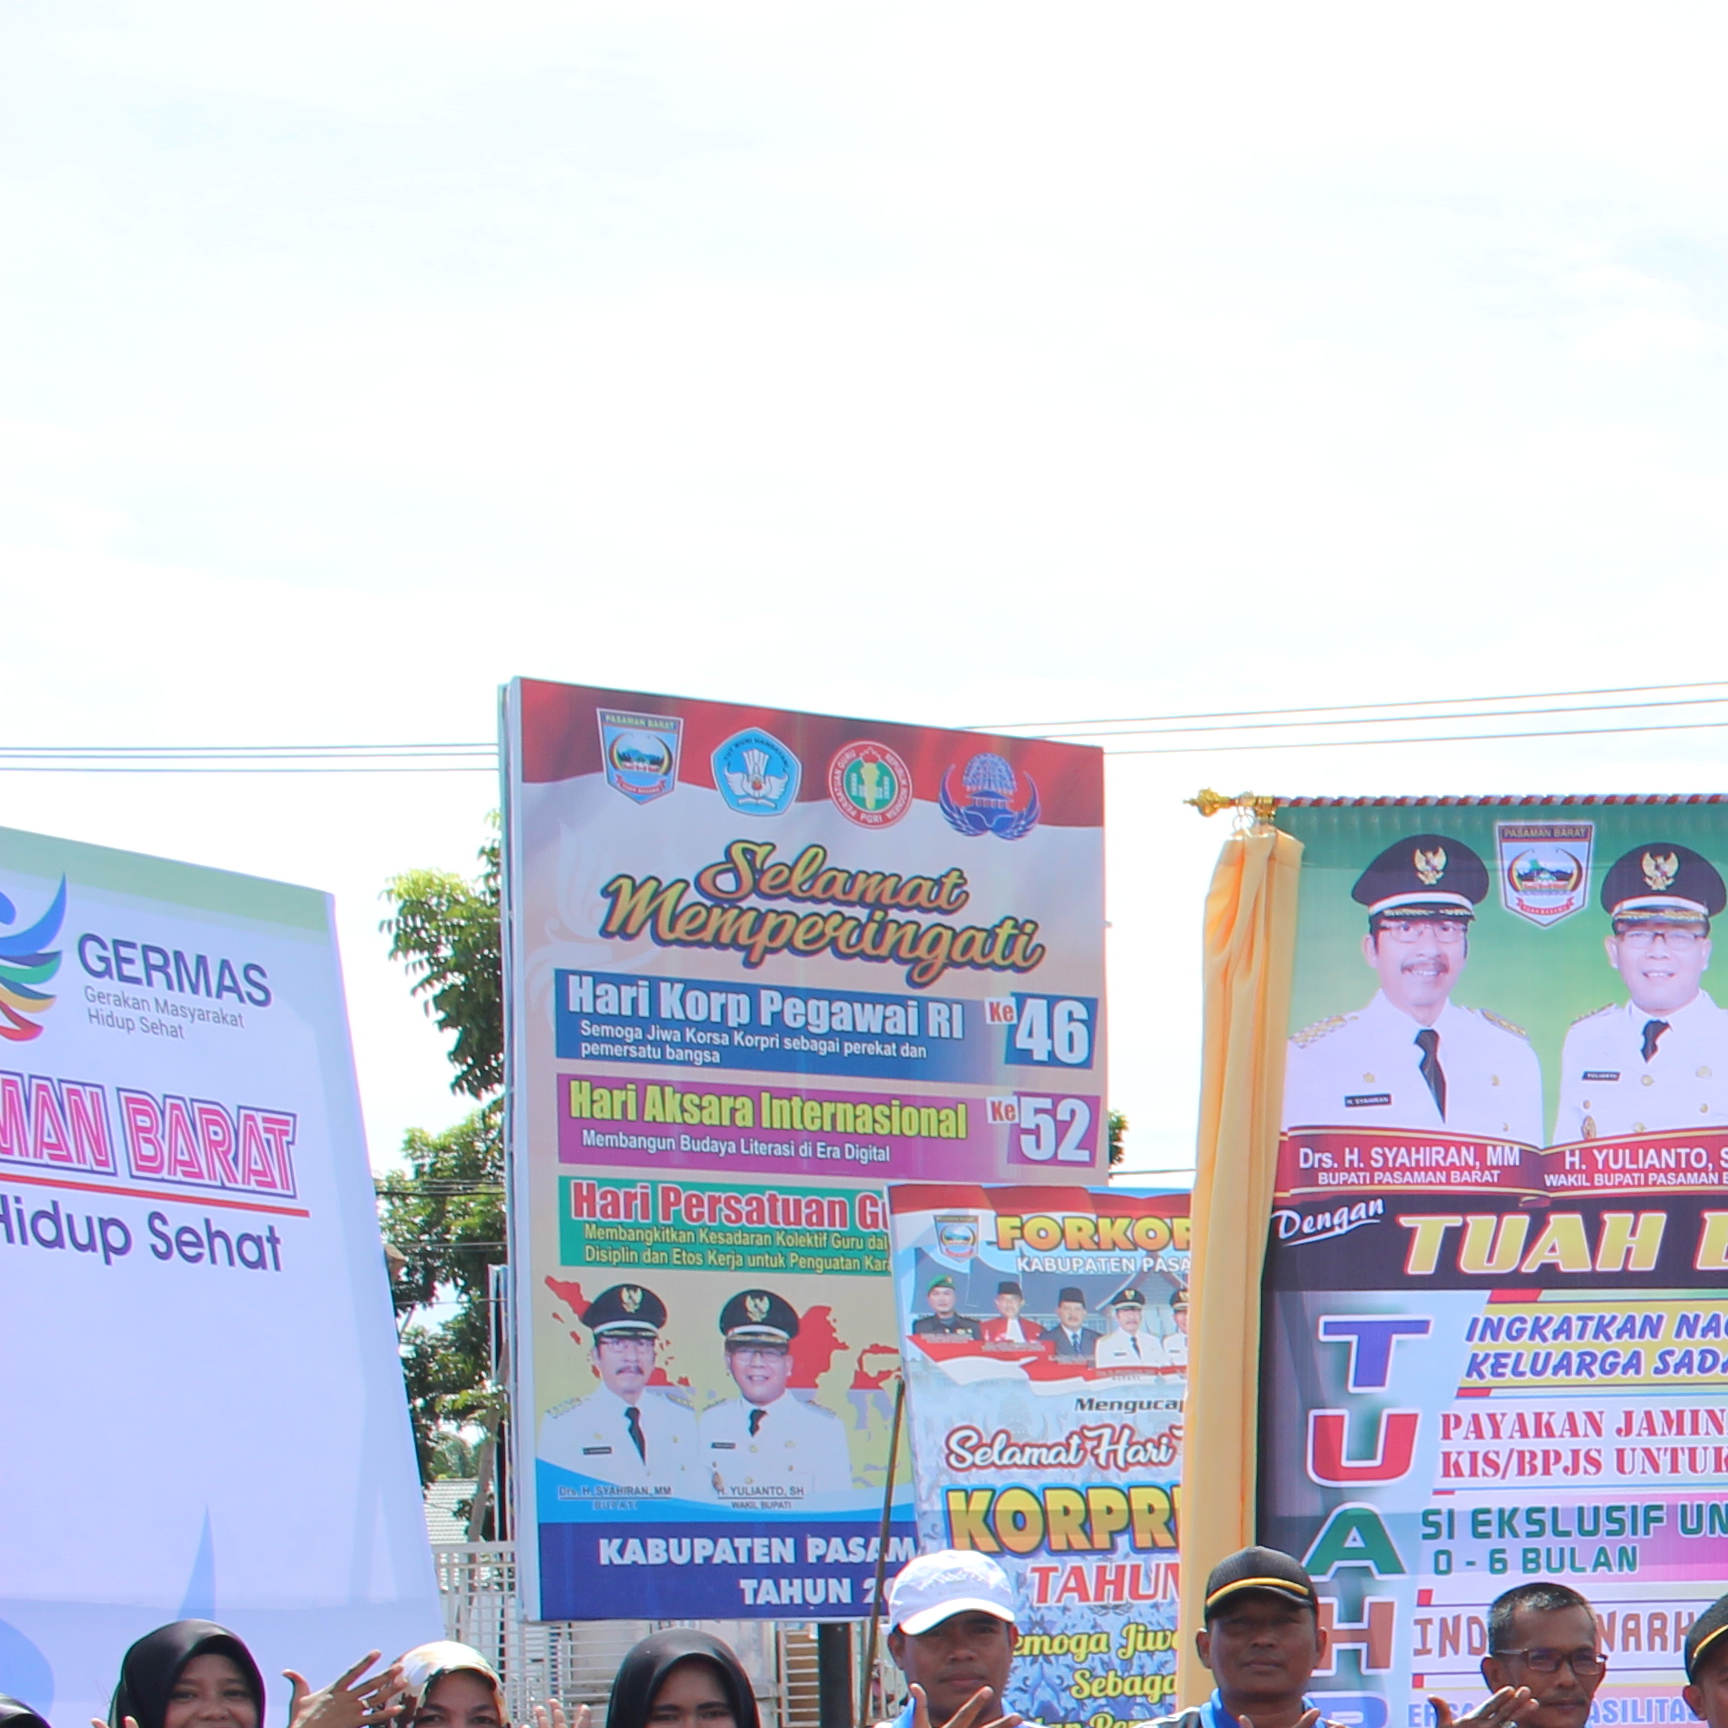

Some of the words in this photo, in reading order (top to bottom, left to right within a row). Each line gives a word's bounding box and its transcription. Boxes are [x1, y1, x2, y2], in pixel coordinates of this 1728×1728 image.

[697, 840, 968, 914] Selamat
[601, 876, 1046, 988] Memperingati
[78, 934, 272, 1007] GERMAS
[84, 986, 151, 1012] Gerakan
[154, 999, 245, 1029] Masyarakat
[88, 1008, 136, 1034] Hidup
[140, 1017, 185, 1040] Sehat
[567, 974, 650, 1018] Hari
[658, 981, 752, 1028] Korp
[759, 989, 919, 1037] Pegawai
[927, 1002, 964, 1039] RI
[580, 1020, 643, 1042] Semoga
[647, 1024, 681, 1043] Jiwa
[685, 1027, 729, 1046] Korsa
[734, 1031, 780, 1051] Korpri
[783, 1035, 840, 1056] sebagai
[843, 1041, 897, 1058] perekat
[900, 1042, 927, 1058] dan
[989, 1001, 1014, 1022] Ke
[1015, 998, 1090, 1064] 46
[581, 1041, 662, 1061] pemersatu
[665, 1046, 721, 1065] bangsa
[569, 1079, 637, 1121] Hari
[643, 1084, 754, 1129] Aksara
[760, 1092, 968, 1139] Internasional
[0, 1070, 117, 1178] MAN
[116, 1087, 297, 1199] BARAT
[583, 1129, 676, 1156] Membangun
[680, 1134, 737, 1158] Budaya
[740, 1138, 795, 1158] Literasi
[799, 1141, 813, 1158] di
[816, 1142, 841, 1160] Era
[844, 1143, 891, 1165] Digital
[990, 1100, 1016, 1121] Ke
[1018, 1096, 1093, 1162] 52
[1299, 1149, 1339, 1170] Drs.
[1344, 1149, 1365, 1169] H.
[1370, 1147, 1480, 1170] SYAHIRAN,
[1486, 1146, 1521, 1167] MM
[1564, 1149, 1587, 1170] H.
[1592, 1148, 1713, 1172] YULIANTO,
[1318, 1171, 1371, 1185] BUPATI
[1374, 1171, 1447, 1185] PASAMAN
[1450, 1169, 1501, 1184] BARAT
[1544, 1173, 1591, 1187] WAKIL
[1594, 1172, 1646, 1187] BUPATI
[1648, 1172, 1720, 1186] PASAMAN
[571, 1180, 652, 1222] Hari
[658, 1182, 850, 1231] Persatuan
[1271, 1198, 1385, 1240] Dengan
[147, 1211, 281, 1272] Sehat
[1396, 1211, 1668, 1275] TUAH
[1016, 1257, 1136, 1273] KABUPATEN
[1464, 1313, 1665, 1344] INGKATKAN
[1465, 1350, 1644, 1380] KELUARGA
[1440, 1410, 1605, 1441] PAYAKAN
[947, 1424, 1090, 1472] Selamat
[1081, 1423, 1178, 1472] Hari
[1440, 1447, 1603, 1480] KIS/BPJS
[1421, 1507, 1455, 1540] SI
[1470, 1504, 1667, 1540] EKSLUSIF
[599, 1537, 796, 1566] KABUPATEN
[1489, 1548, 1508, 1575] 6
[1522, 1545, 1639, 1575] BULAN
[739, 1578, 853, 1605] TAHUN
